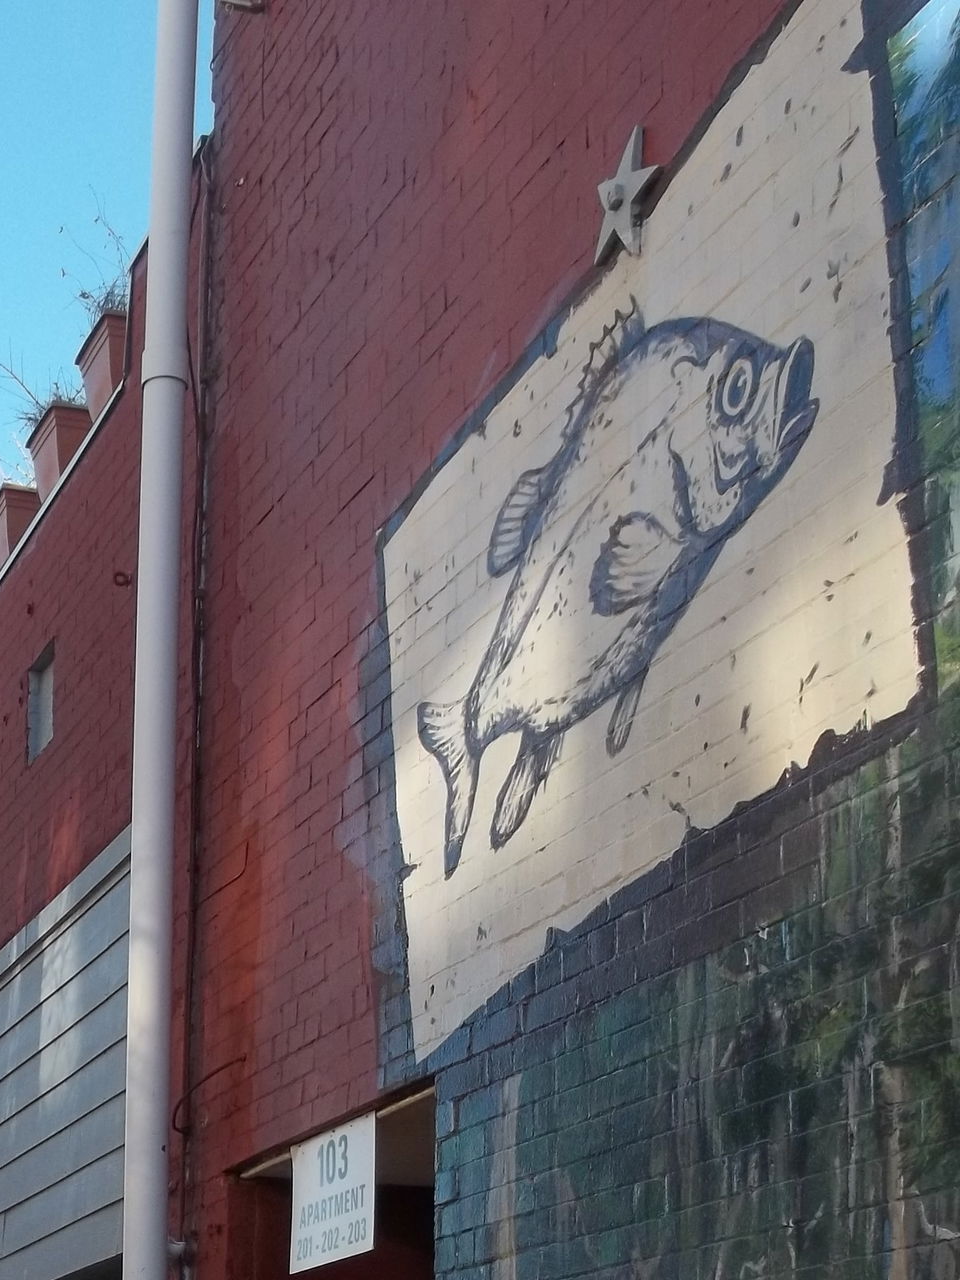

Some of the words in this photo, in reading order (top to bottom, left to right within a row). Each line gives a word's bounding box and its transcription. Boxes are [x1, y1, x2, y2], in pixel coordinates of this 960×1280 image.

[317, 1134, 349, 1188] 103
[299, 1183, 366, 1230] APARTMENT
[296, 1235, 313, 1261] 201
[321, 1226, 340, 1254] 202
[347, 1217, 367, 1246] 203
